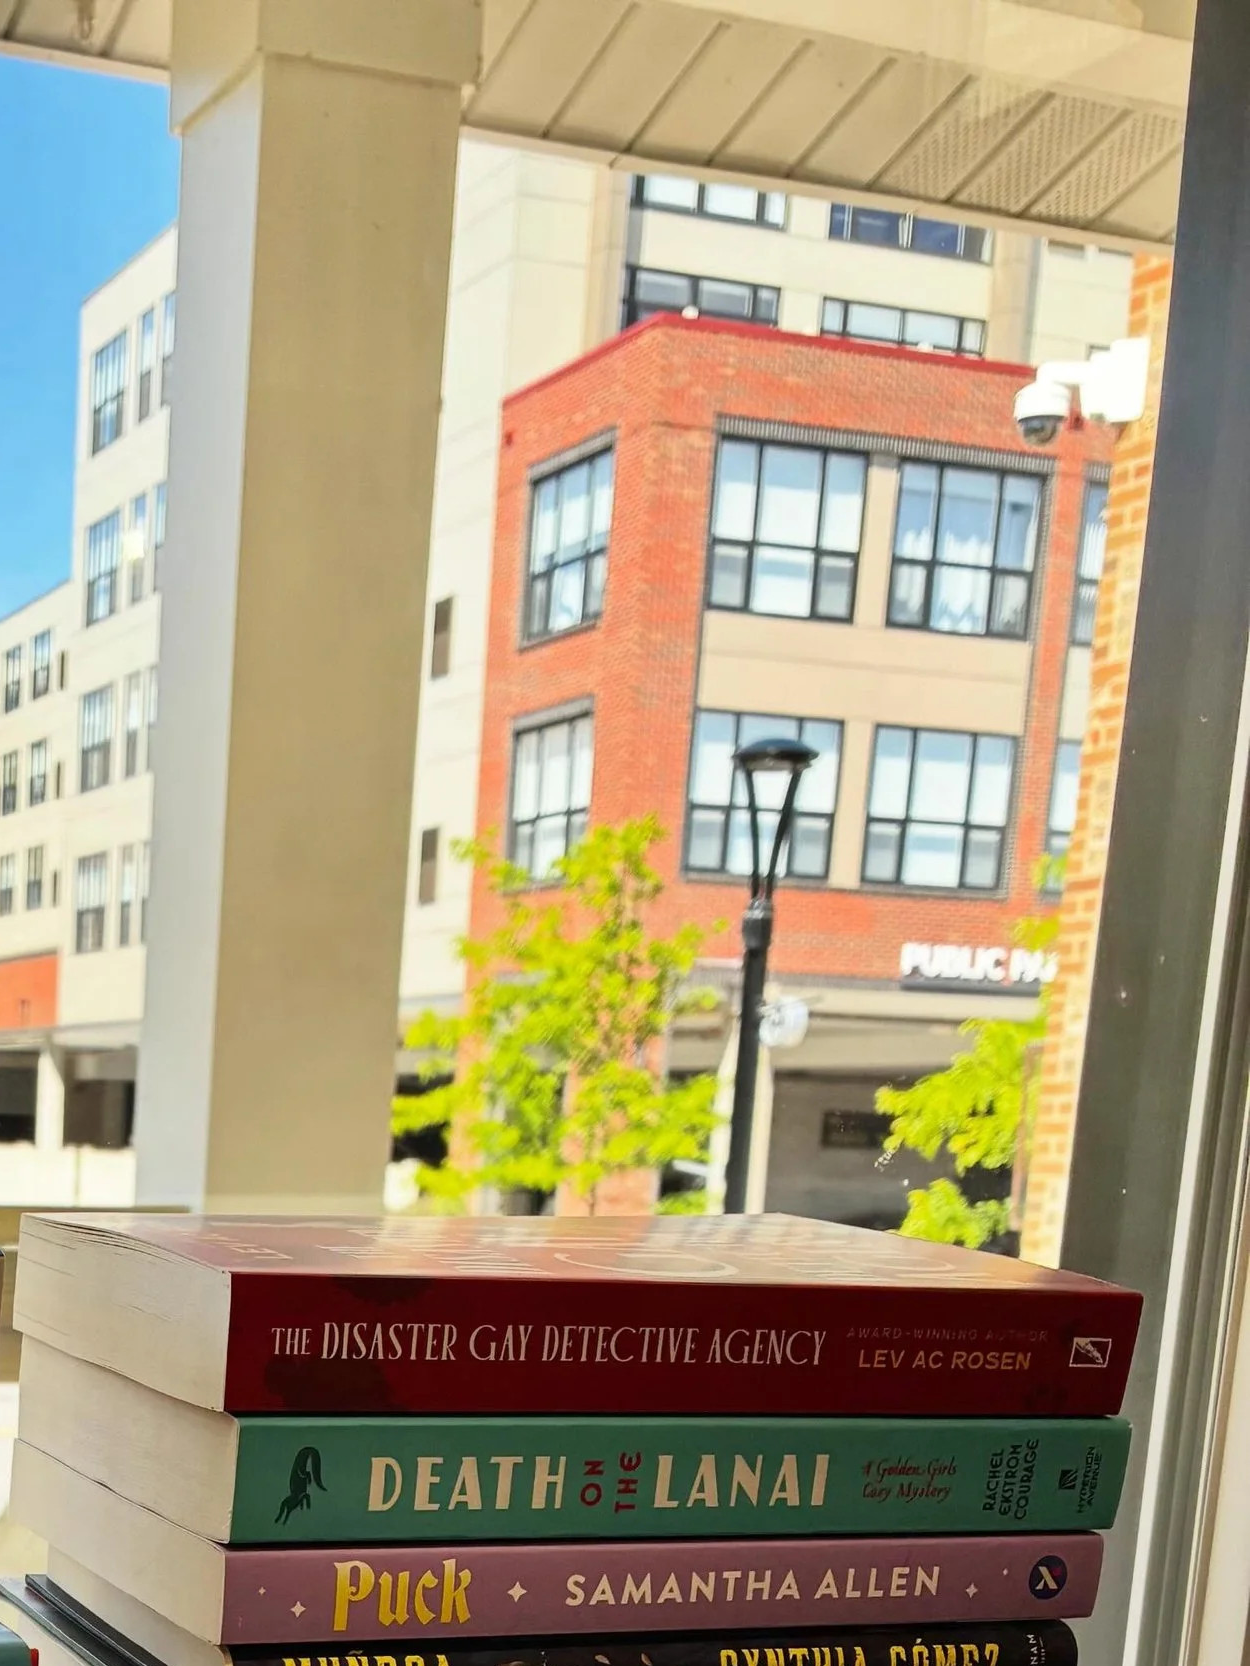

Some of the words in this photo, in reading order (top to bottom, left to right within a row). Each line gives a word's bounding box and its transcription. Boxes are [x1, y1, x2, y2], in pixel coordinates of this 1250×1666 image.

[901, 942, 1008, 980] PUBLIC
[271, 1326, 311, 1356] THE
[321, 1321, 457, 1362] DISASTER
[469, 1324, 533, 1363] GAY
[542, 1324, 701, 1365] DETECTIVE
[707, 1328, 826, 1366] AGENCY
[858, 1349, 906, 1369] LEV
[912, 1350, 944, 1369] AC
[951, 1351, 1032, 1370] ROSEN
[368, 1456, 567, 1512] DEATH
[580, 1460, 605, 1507] ON
[614, 1451, 642, 1514] THE
[653, 1453, 830, 1509] LANAI
[982, 1450, 1004, 1512] RACHEL
[999, 1444, 1023, 1517] EKSTROM
[1014, 1438, 1039, 1520] COURAGE
[333, 1558, 473, 1632] Puck
[565, 1569, 798, 1607] SAMANTHA
[815, 1566, 941, 1601] ALLEN
